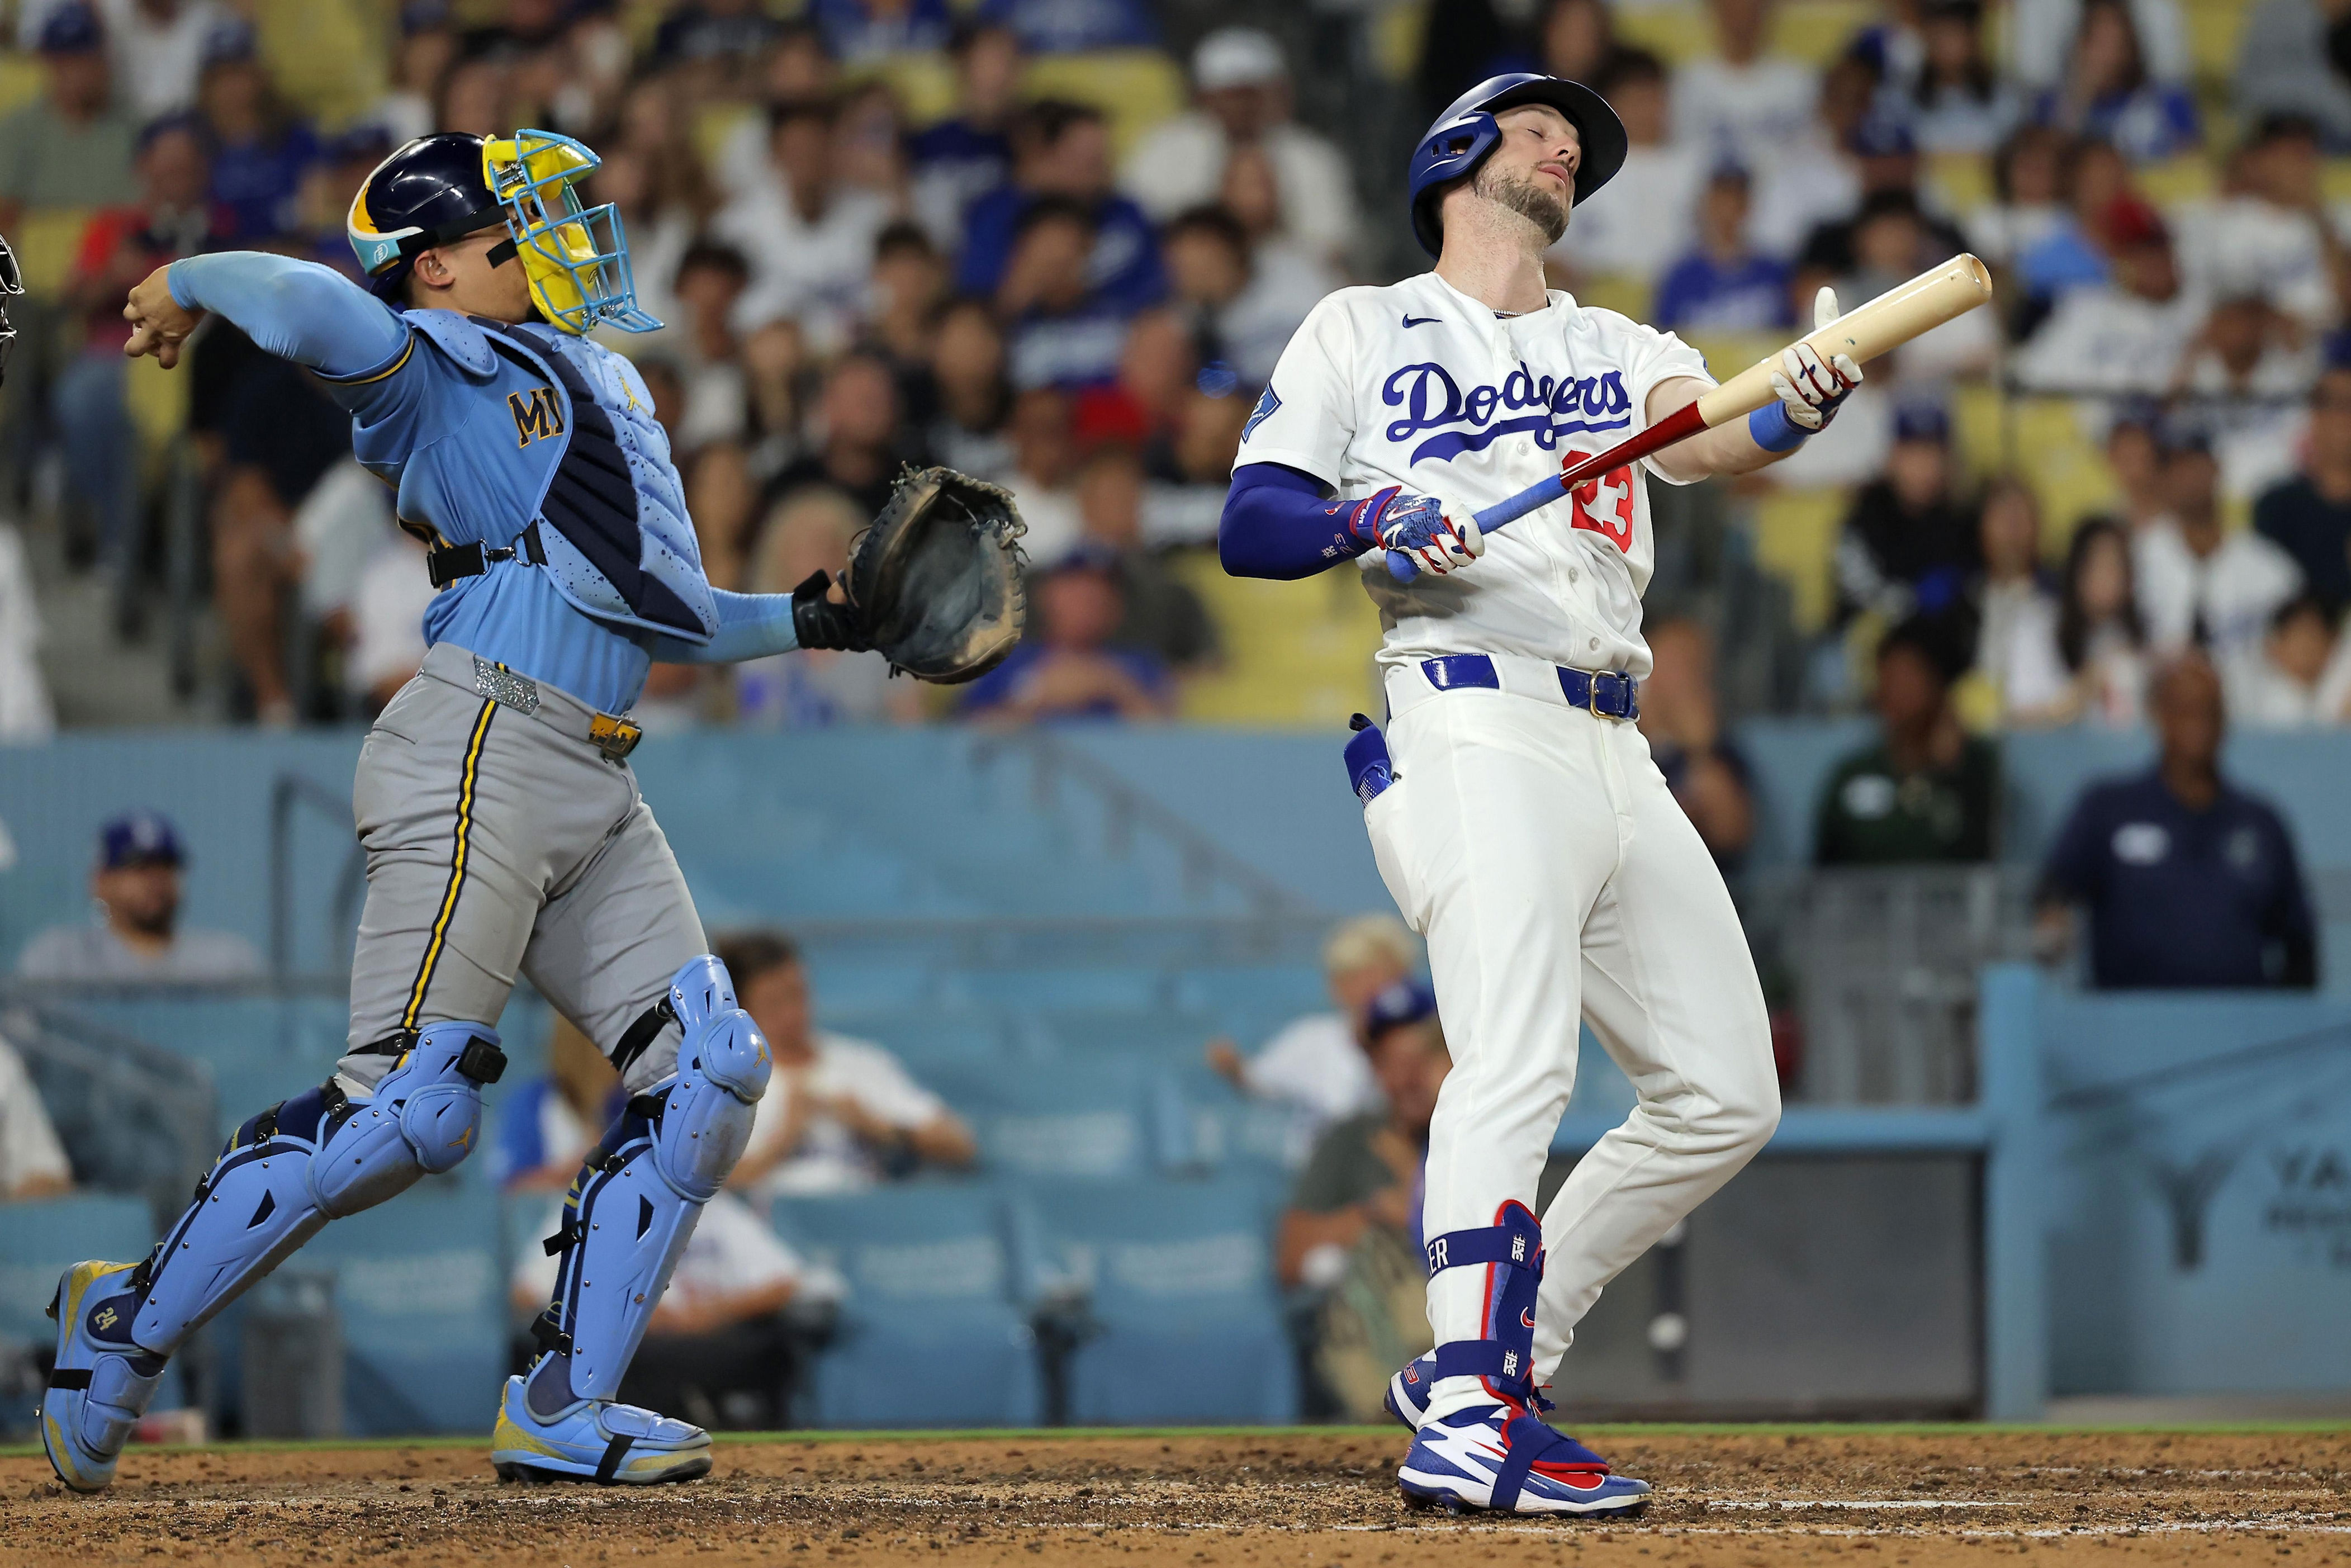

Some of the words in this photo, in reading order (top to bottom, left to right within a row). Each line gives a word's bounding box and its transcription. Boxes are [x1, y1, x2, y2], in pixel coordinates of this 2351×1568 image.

[1382, 361, 1632, 451] Dodgers
[1561, 449, 1634, 553] 23
[1428, 1238, 1449, 1277] ER
[94, 1306, 119, 1331] 24
